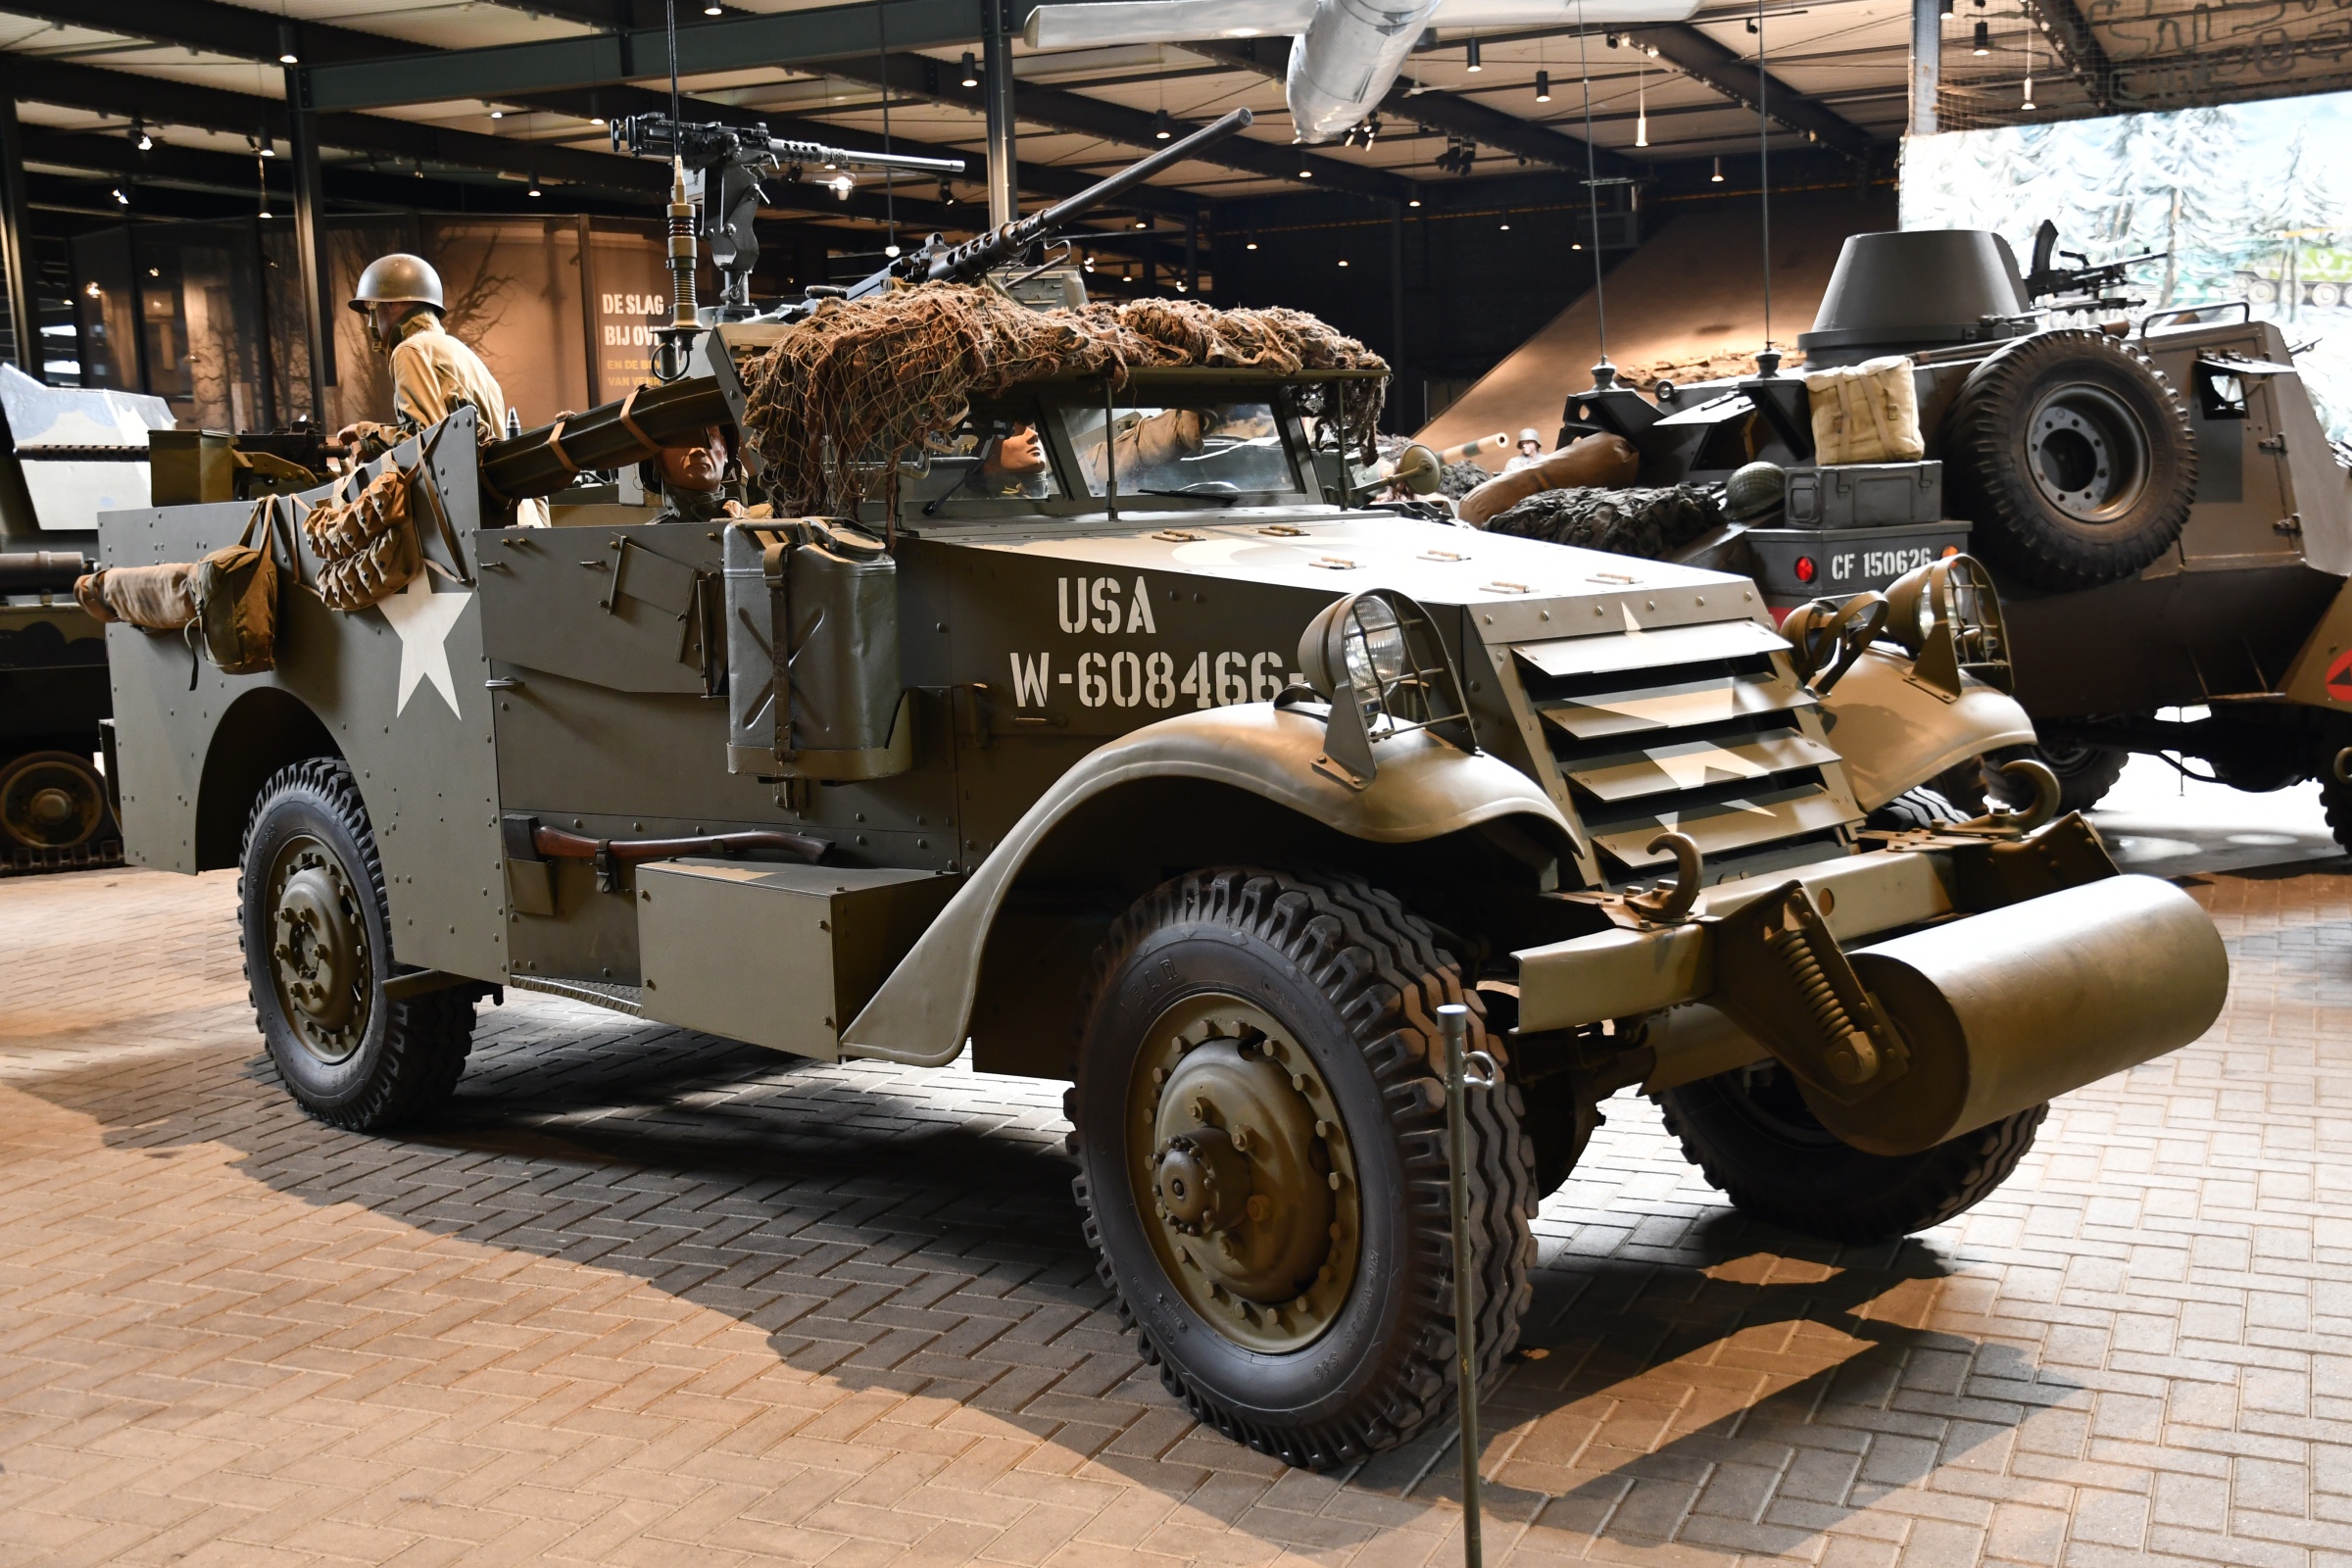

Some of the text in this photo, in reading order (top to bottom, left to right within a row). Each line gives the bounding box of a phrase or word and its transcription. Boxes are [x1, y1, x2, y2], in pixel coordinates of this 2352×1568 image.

[601, 293, 664, 316] DE SLAG
[604, 324, 630, 346] BIJ
[607, 360, 622, 369] EN
[624, 360, 639, 369] DE
[608, 376, 630, 386] VAN
[1831, 547, 1932, 580] CF 150626
[1057, 575, 1156, 634] USA
